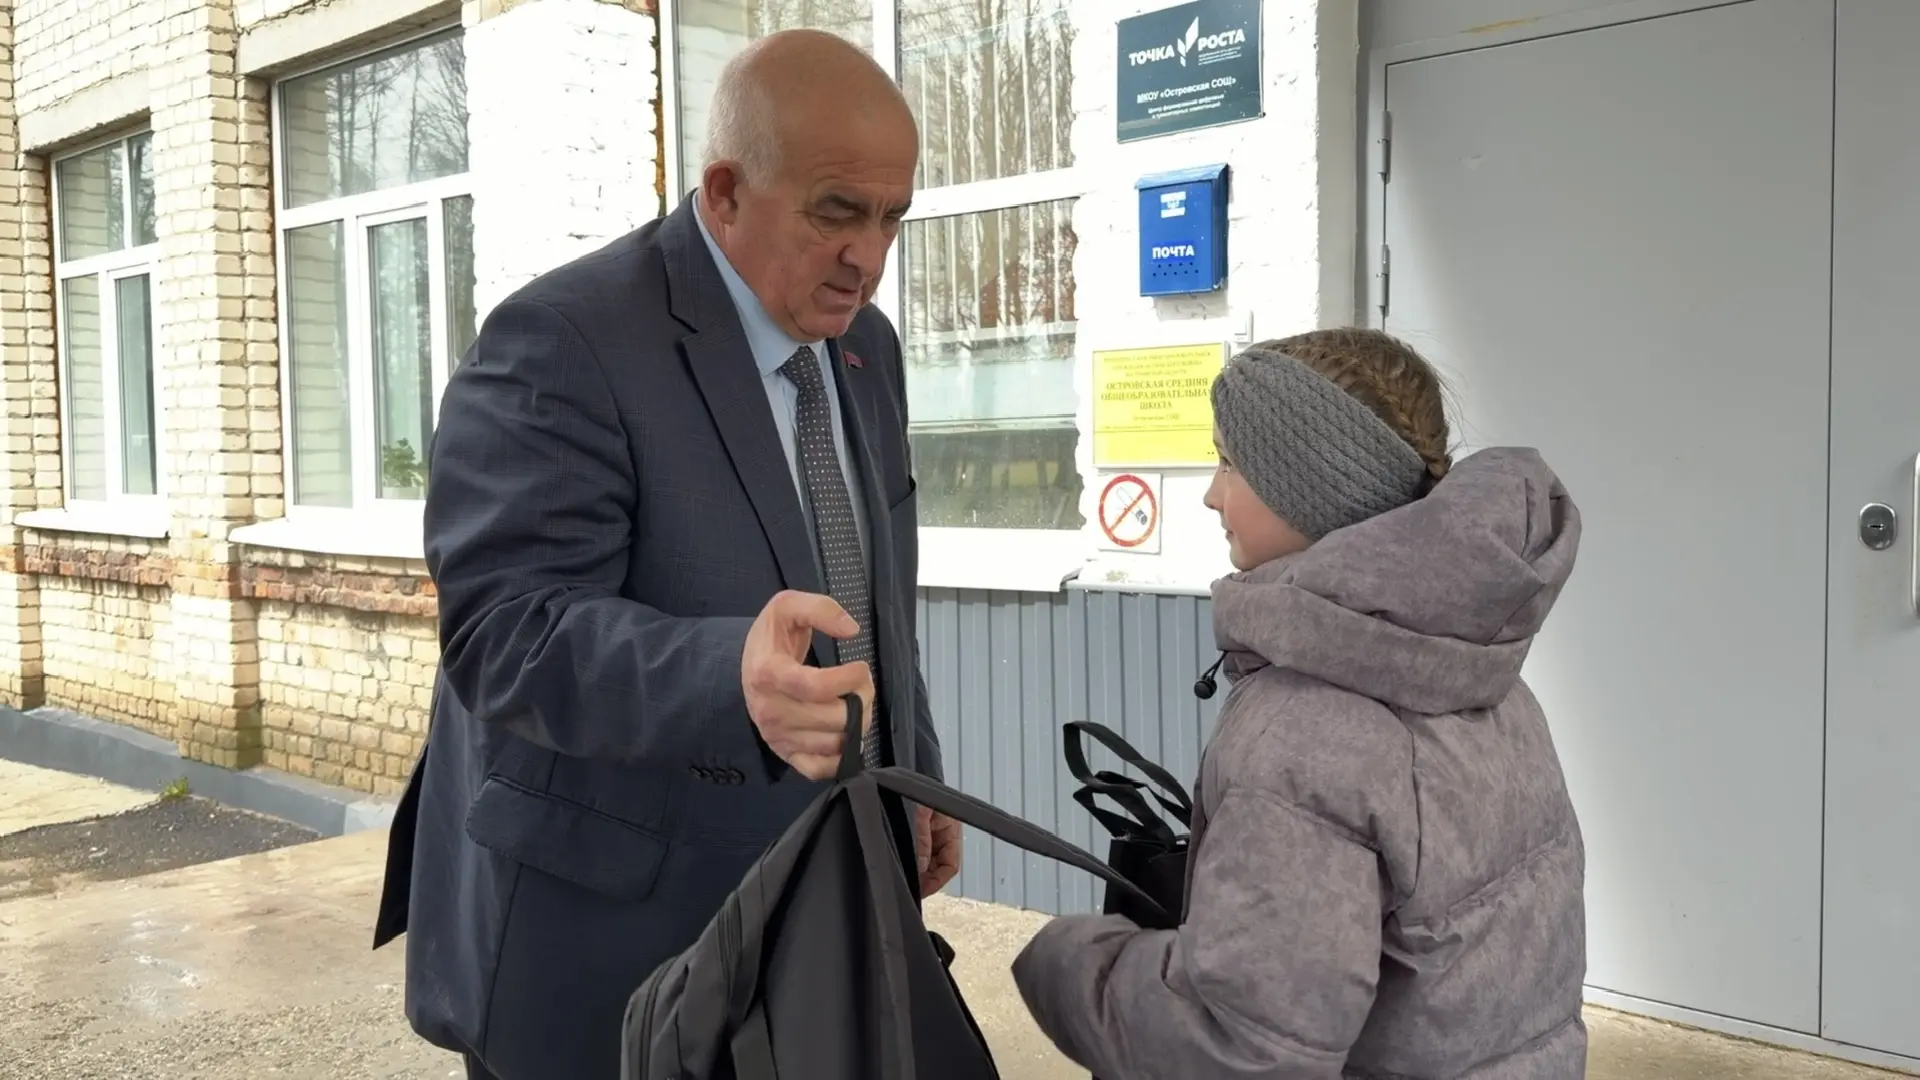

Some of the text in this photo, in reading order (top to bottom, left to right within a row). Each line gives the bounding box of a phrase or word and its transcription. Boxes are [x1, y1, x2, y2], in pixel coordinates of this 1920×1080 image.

[1129, 45, 1175, 66] ТОЧКА
[1198, 29, 1245, 51] РОСТА
[1136, 91, 1159, 104] МКОУ
[1160, 82, 1210, 98] «Островская
[1152, 245, 1195, 259] ПОЧТА
[1106, 377, 1208, 390] ОСТРОВСКАЯ СРЕДНЯЯ
[1139, 400, 1173, 411] ШКОЛА
